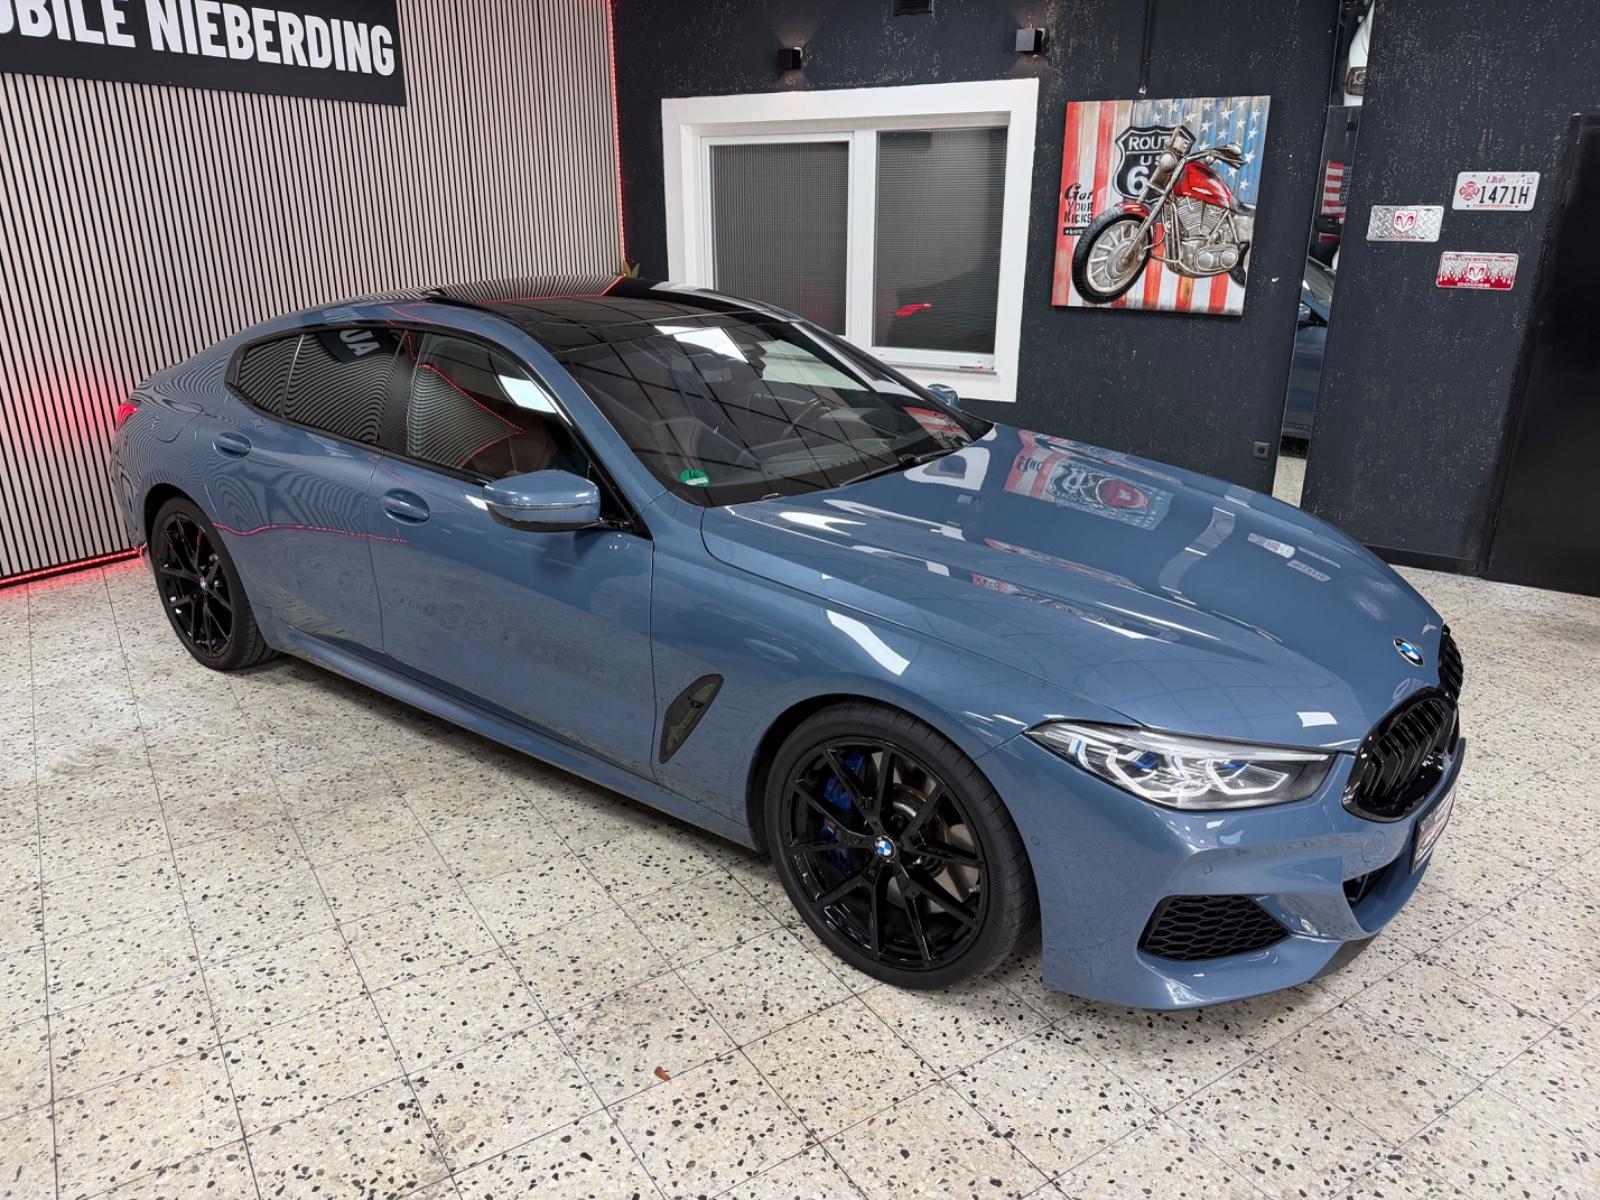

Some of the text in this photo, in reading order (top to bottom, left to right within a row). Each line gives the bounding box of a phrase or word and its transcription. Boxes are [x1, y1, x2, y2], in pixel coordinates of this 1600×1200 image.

[145, 0, 395, 76] NIEBERDING
[1128, 136, 1170, 151] ROUT
[1479, 185, 1530, 204] 1471H
